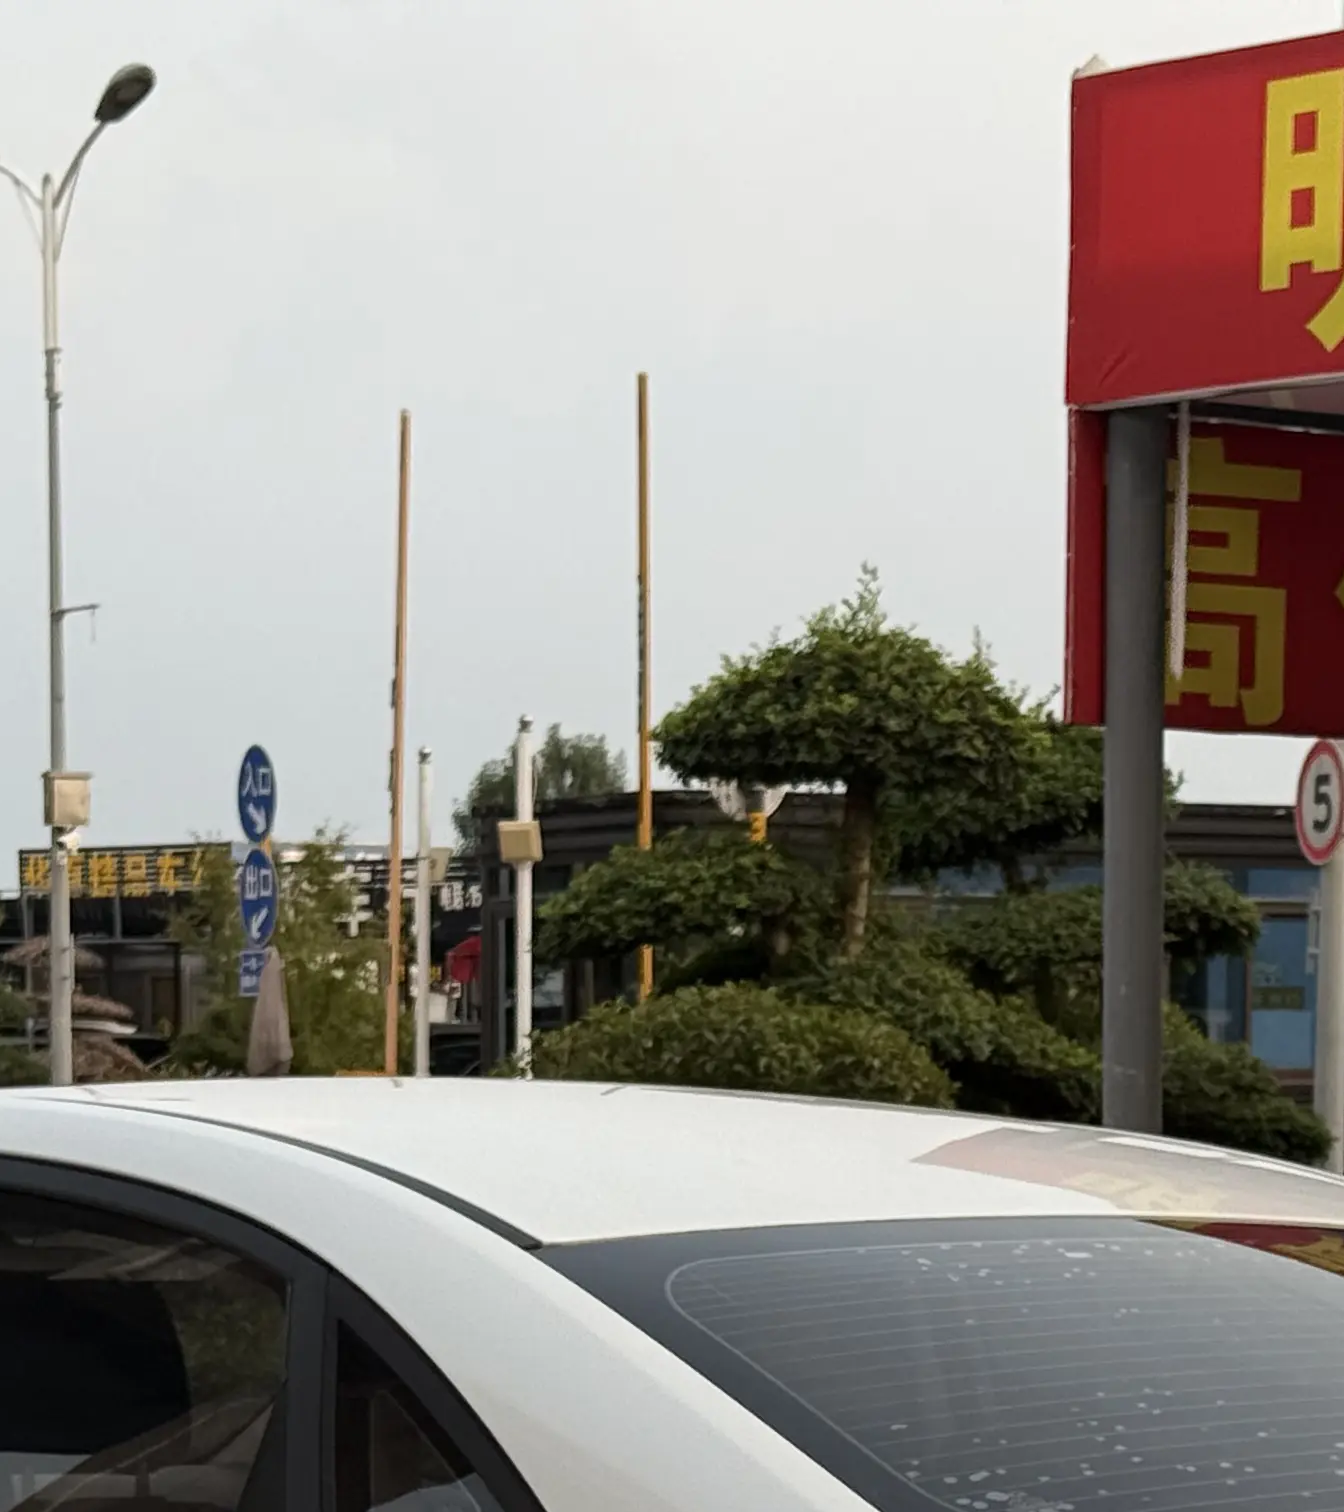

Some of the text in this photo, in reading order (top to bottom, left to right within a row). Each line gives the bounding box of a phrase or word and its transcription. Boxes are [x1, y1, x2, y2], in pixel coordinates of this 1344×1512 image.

[240, 761, 272, 797] 入口
[1312, 773, 1334, 834] 5
[244, 865, 273, 900] 出口
